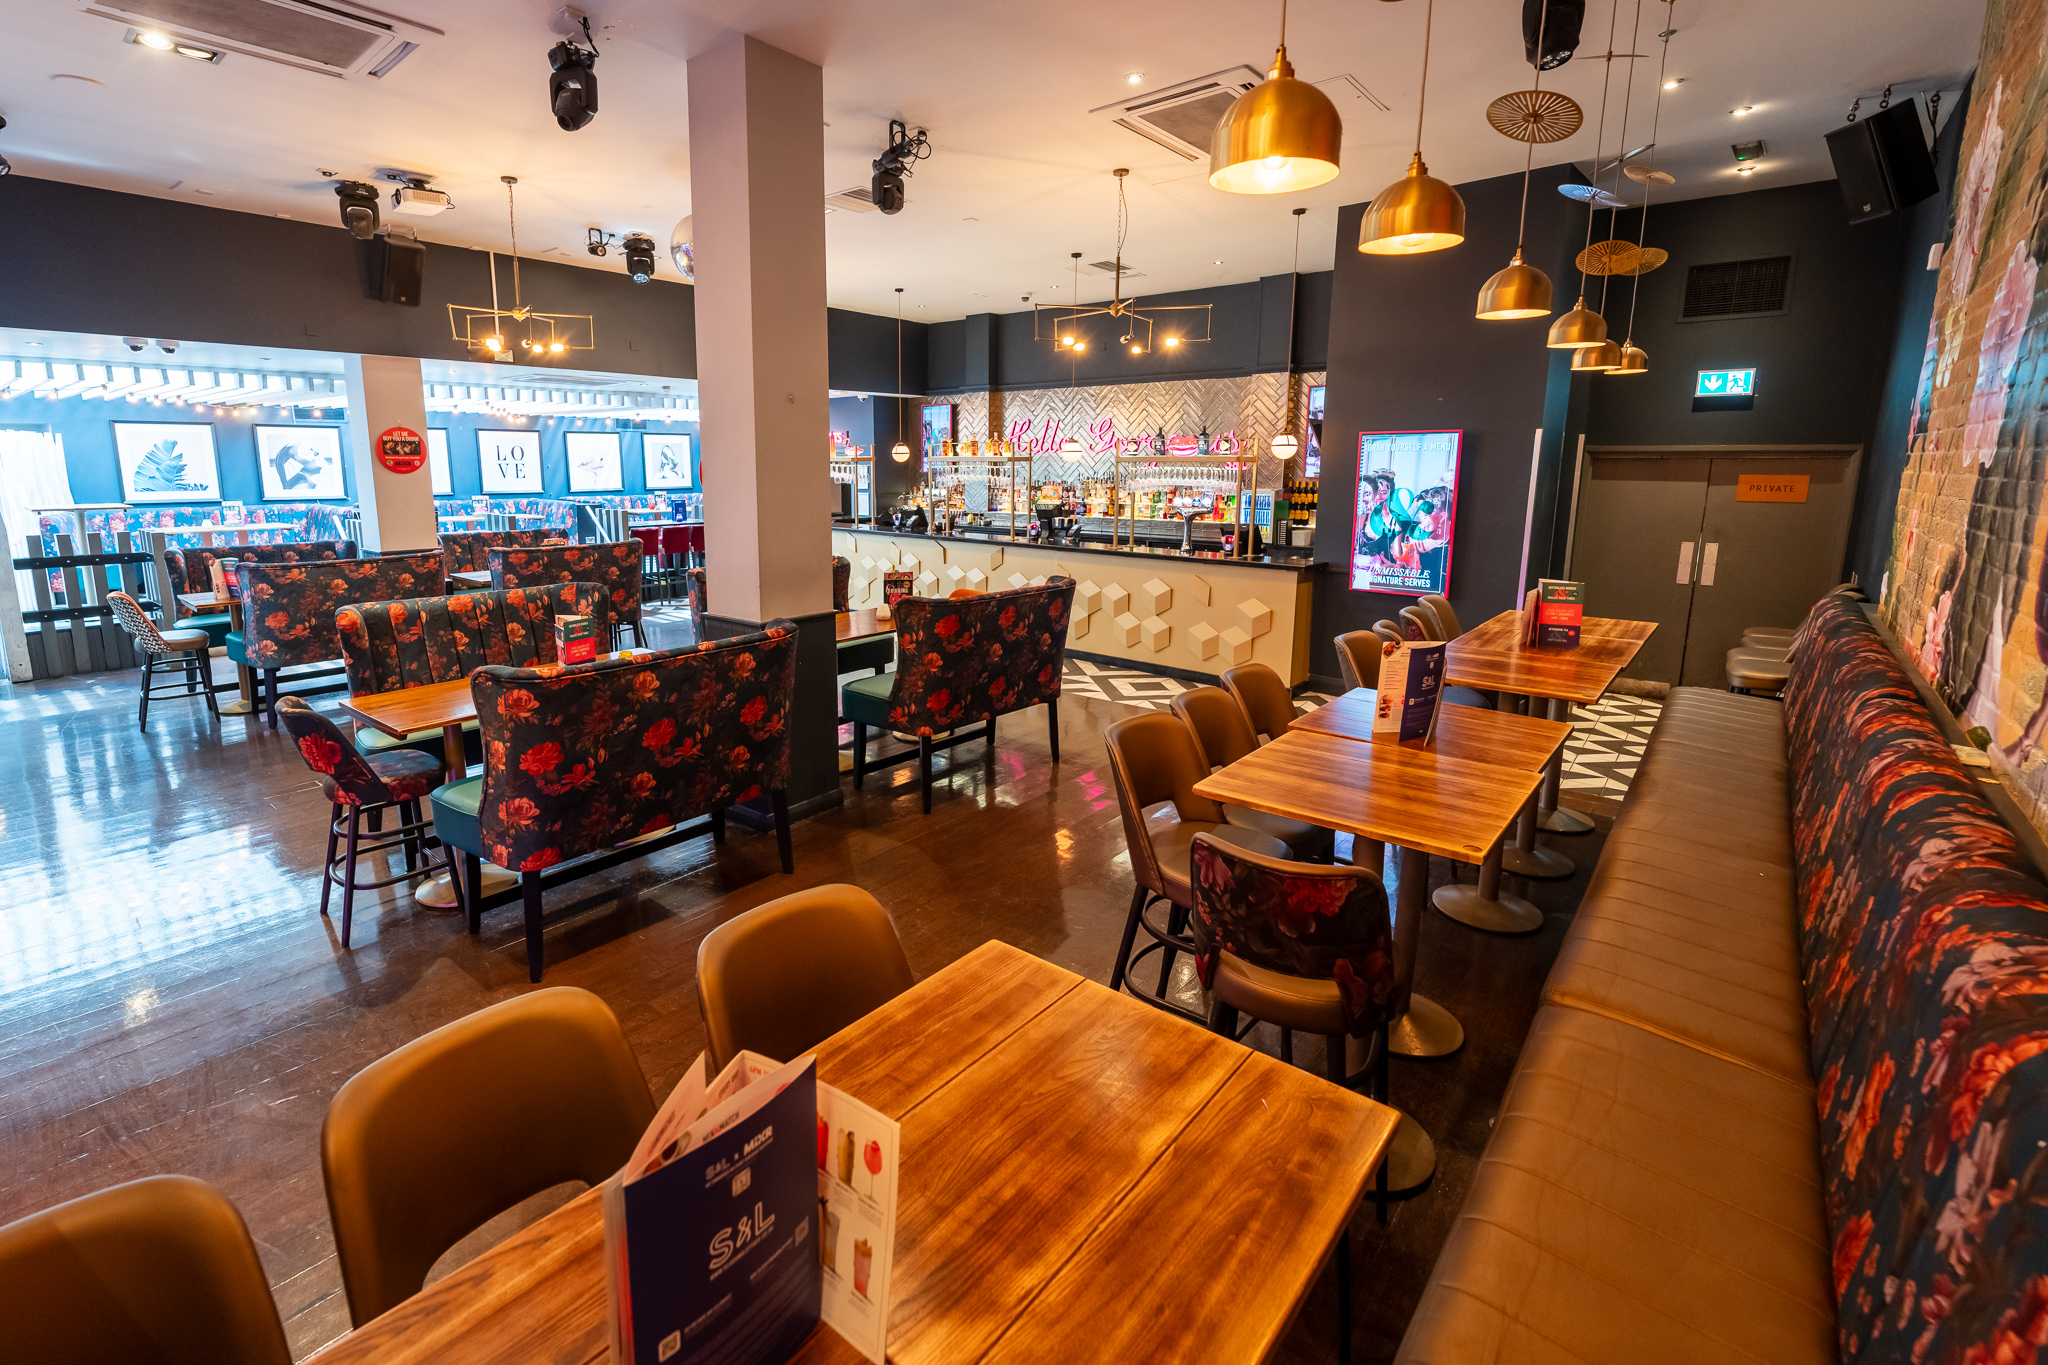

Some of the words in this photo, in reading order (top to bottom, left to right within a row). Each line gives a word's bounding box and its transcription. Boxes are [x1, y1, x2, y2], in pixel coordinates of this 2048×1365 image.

[1367, 443, 1386, 452] GRAB
[1386, 442, 1422, 452] YOURSELF
[1423, 443, 1429, 451] A
[1430, 442, 1452, 452] MENU
[1749, 484, 1796, 493] PRIVATE
[1370, 575, 1404, 586] IGNATURE
[1404, 577, 1431, 588] SERVES
[709, 1200, 776, 1270] S&L
